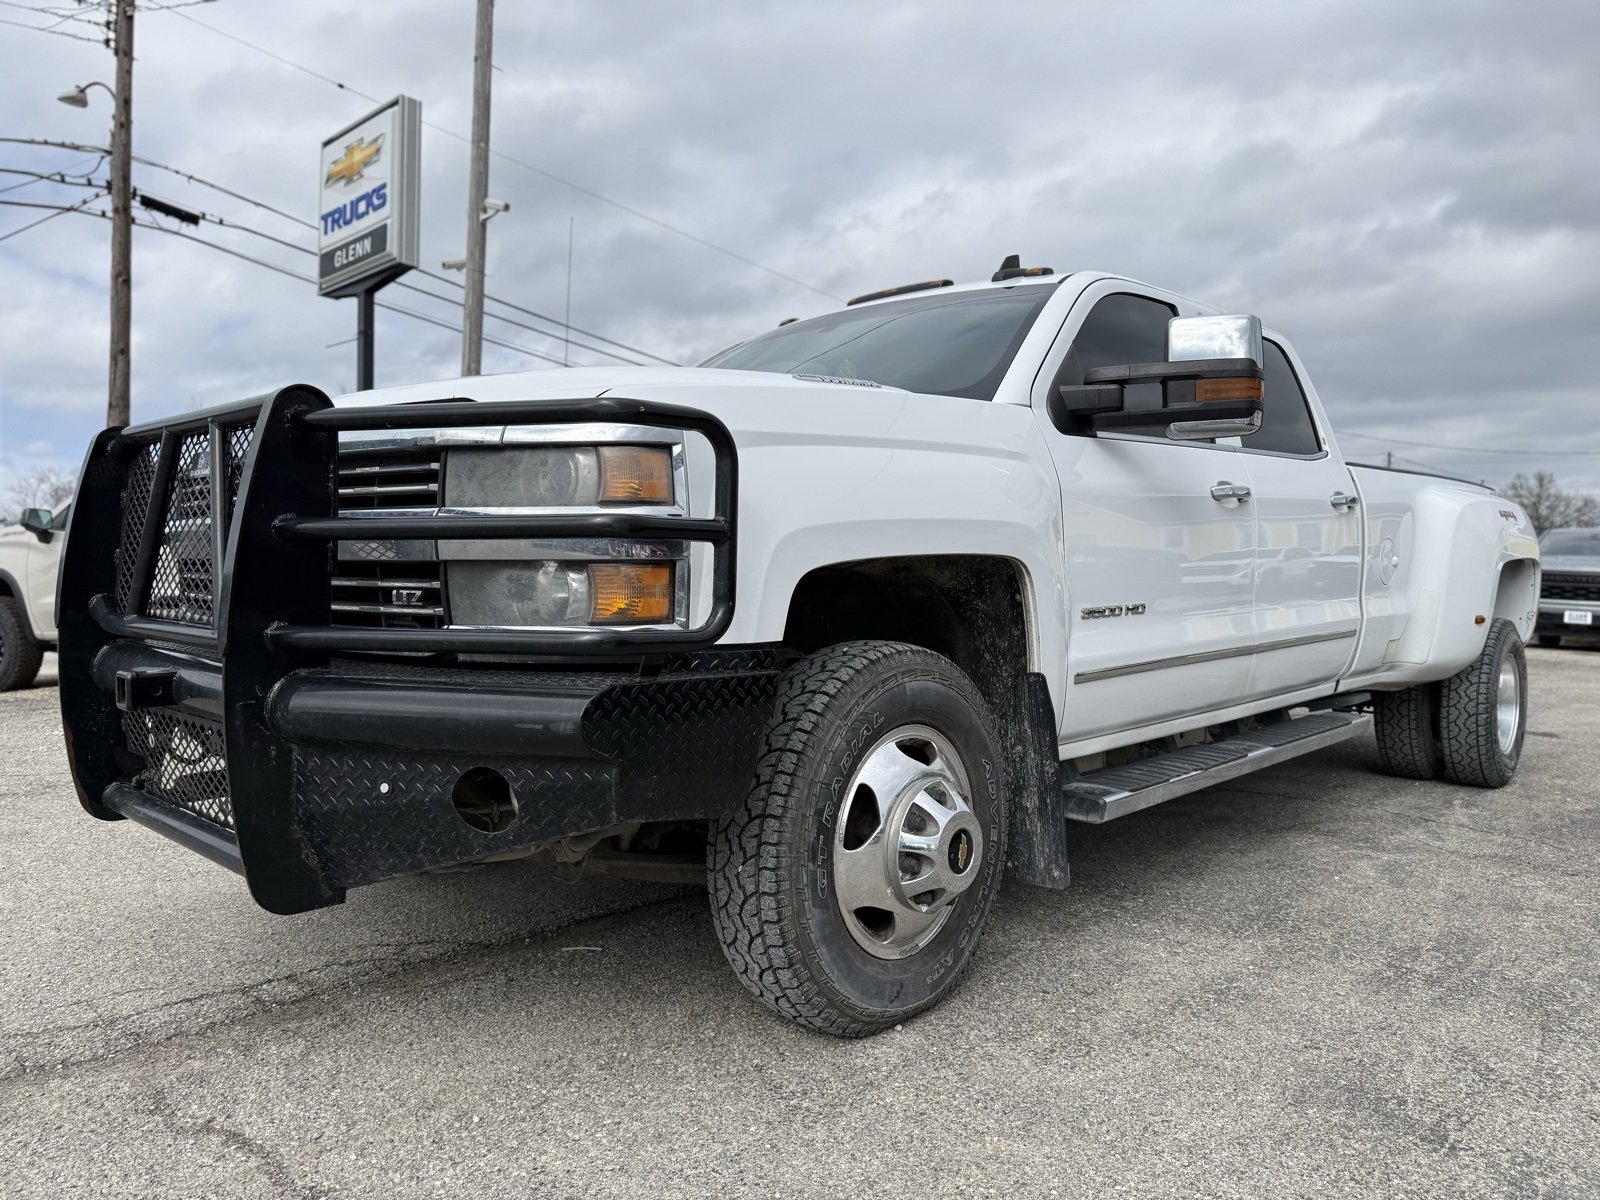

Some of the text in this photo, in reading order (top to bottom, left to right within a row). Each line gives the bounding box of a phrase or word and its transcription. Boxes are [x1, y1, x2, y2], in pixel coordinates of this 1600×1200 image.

[320, 182, 387, 236] TRUCKS
[333, 236, 372, 268] GLENN
[392, 590, 422, 605] LTZ
[1125, 604, 1146, 616] HD
[817, 711, 885, 899] GT RADIAL
[957, 758, 1000, 948] ADVENTURO
